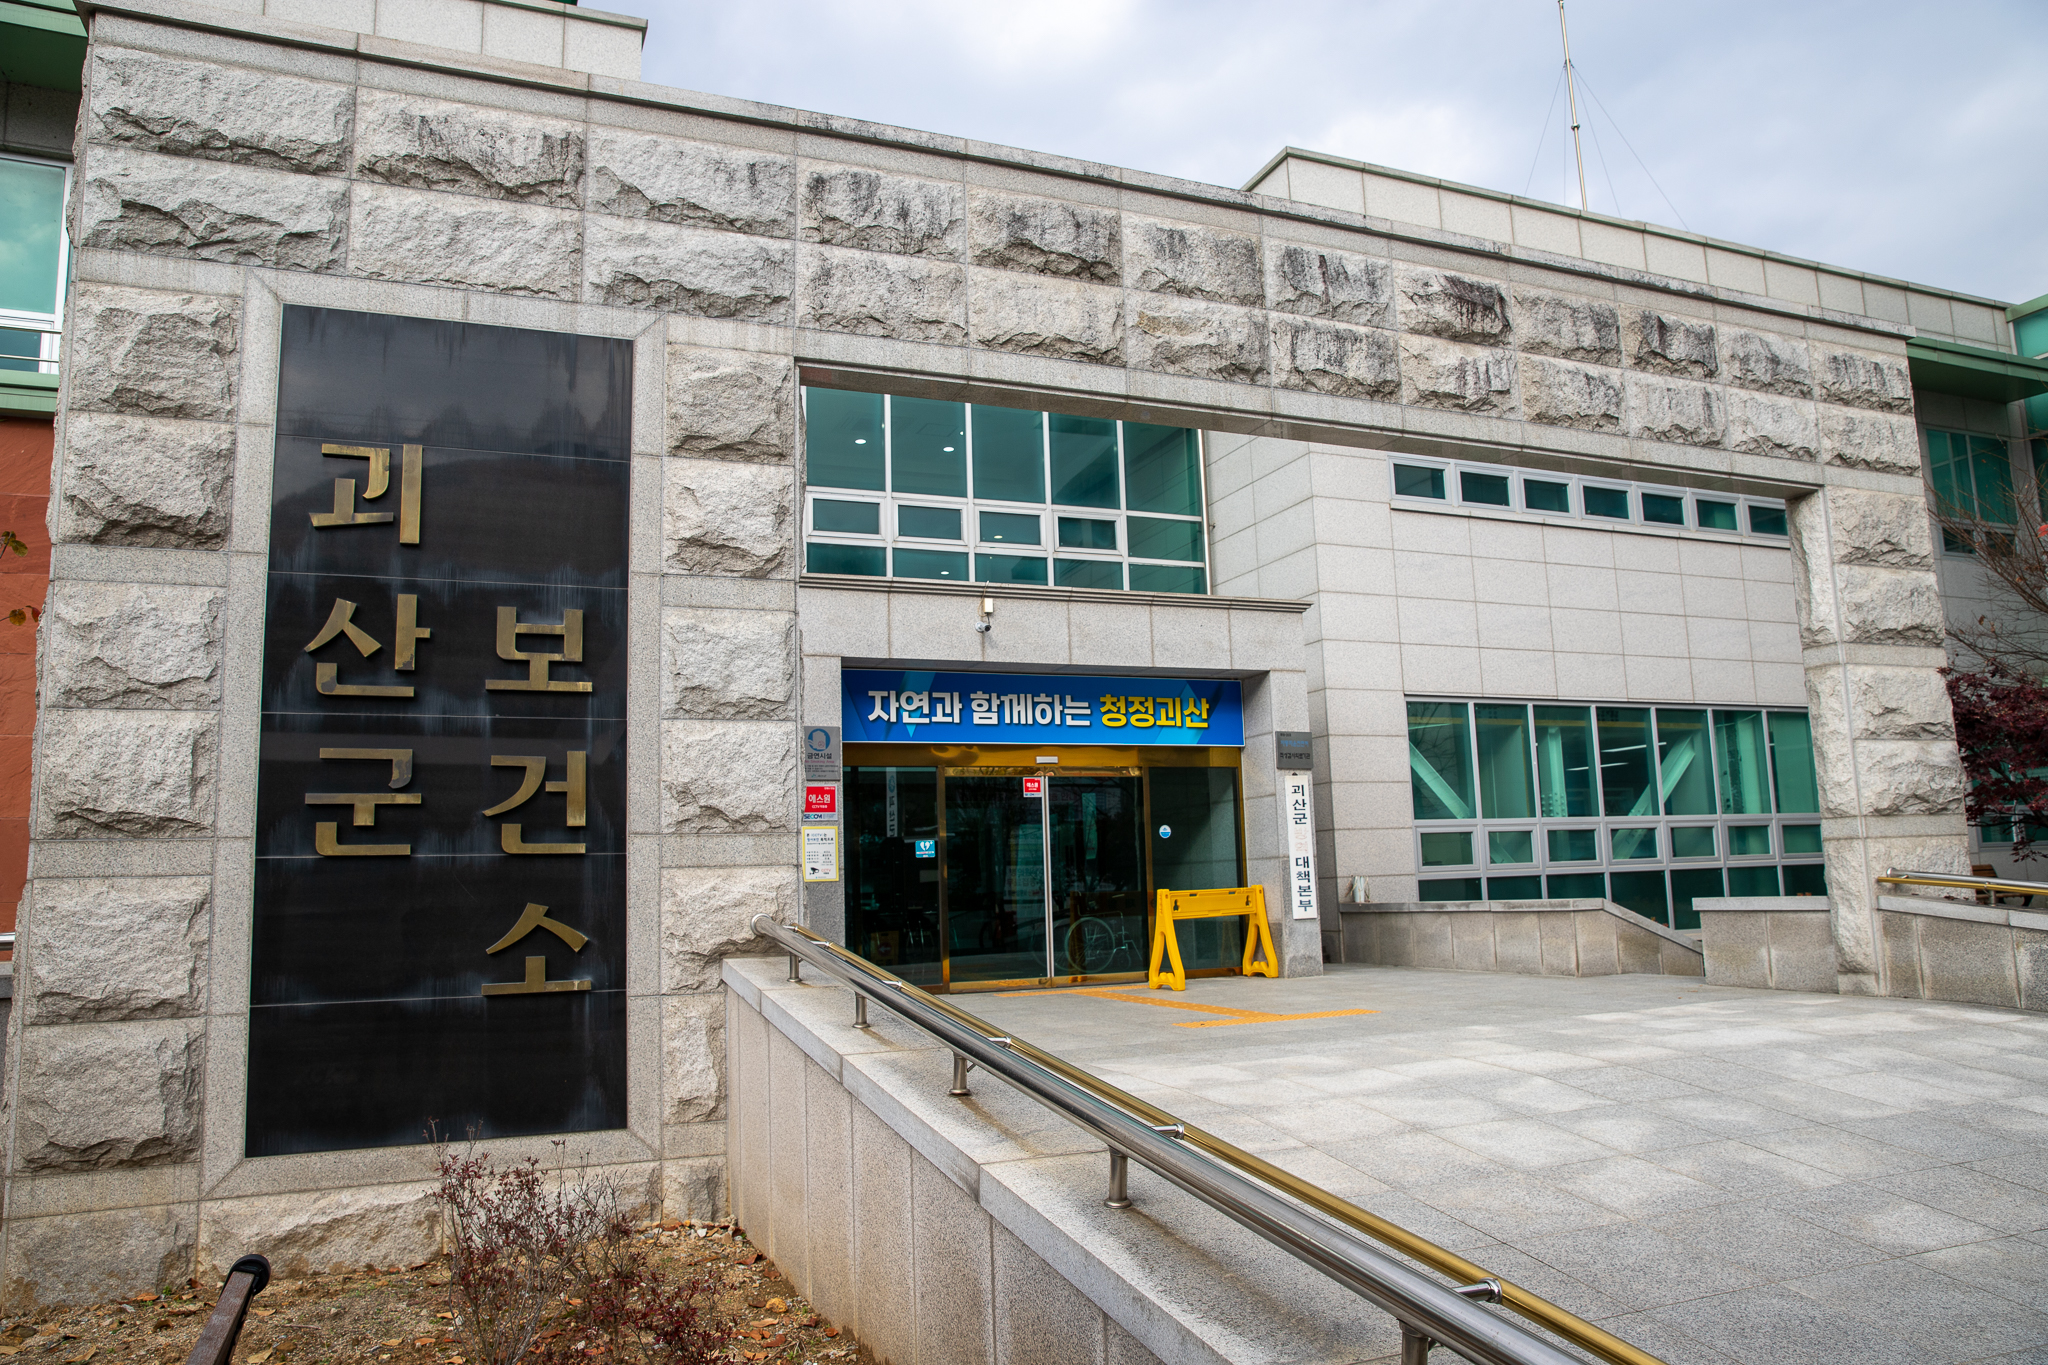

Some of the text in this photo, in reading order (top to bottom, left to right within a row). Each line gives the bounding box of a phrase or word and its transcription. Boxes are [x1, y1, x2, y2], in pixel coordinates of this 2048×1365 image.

[304, 444, 430, 856] 괴산군
[868, 691, 1210, 728] 자연과 함께하는 청정괴산
[481, 606, 592, 995] 보건소
[808, 794, 831, 803] 에스원
[1291, 784, 1308, 825] 괴산군
[1295, 856, 1313, 912] 대책본부
